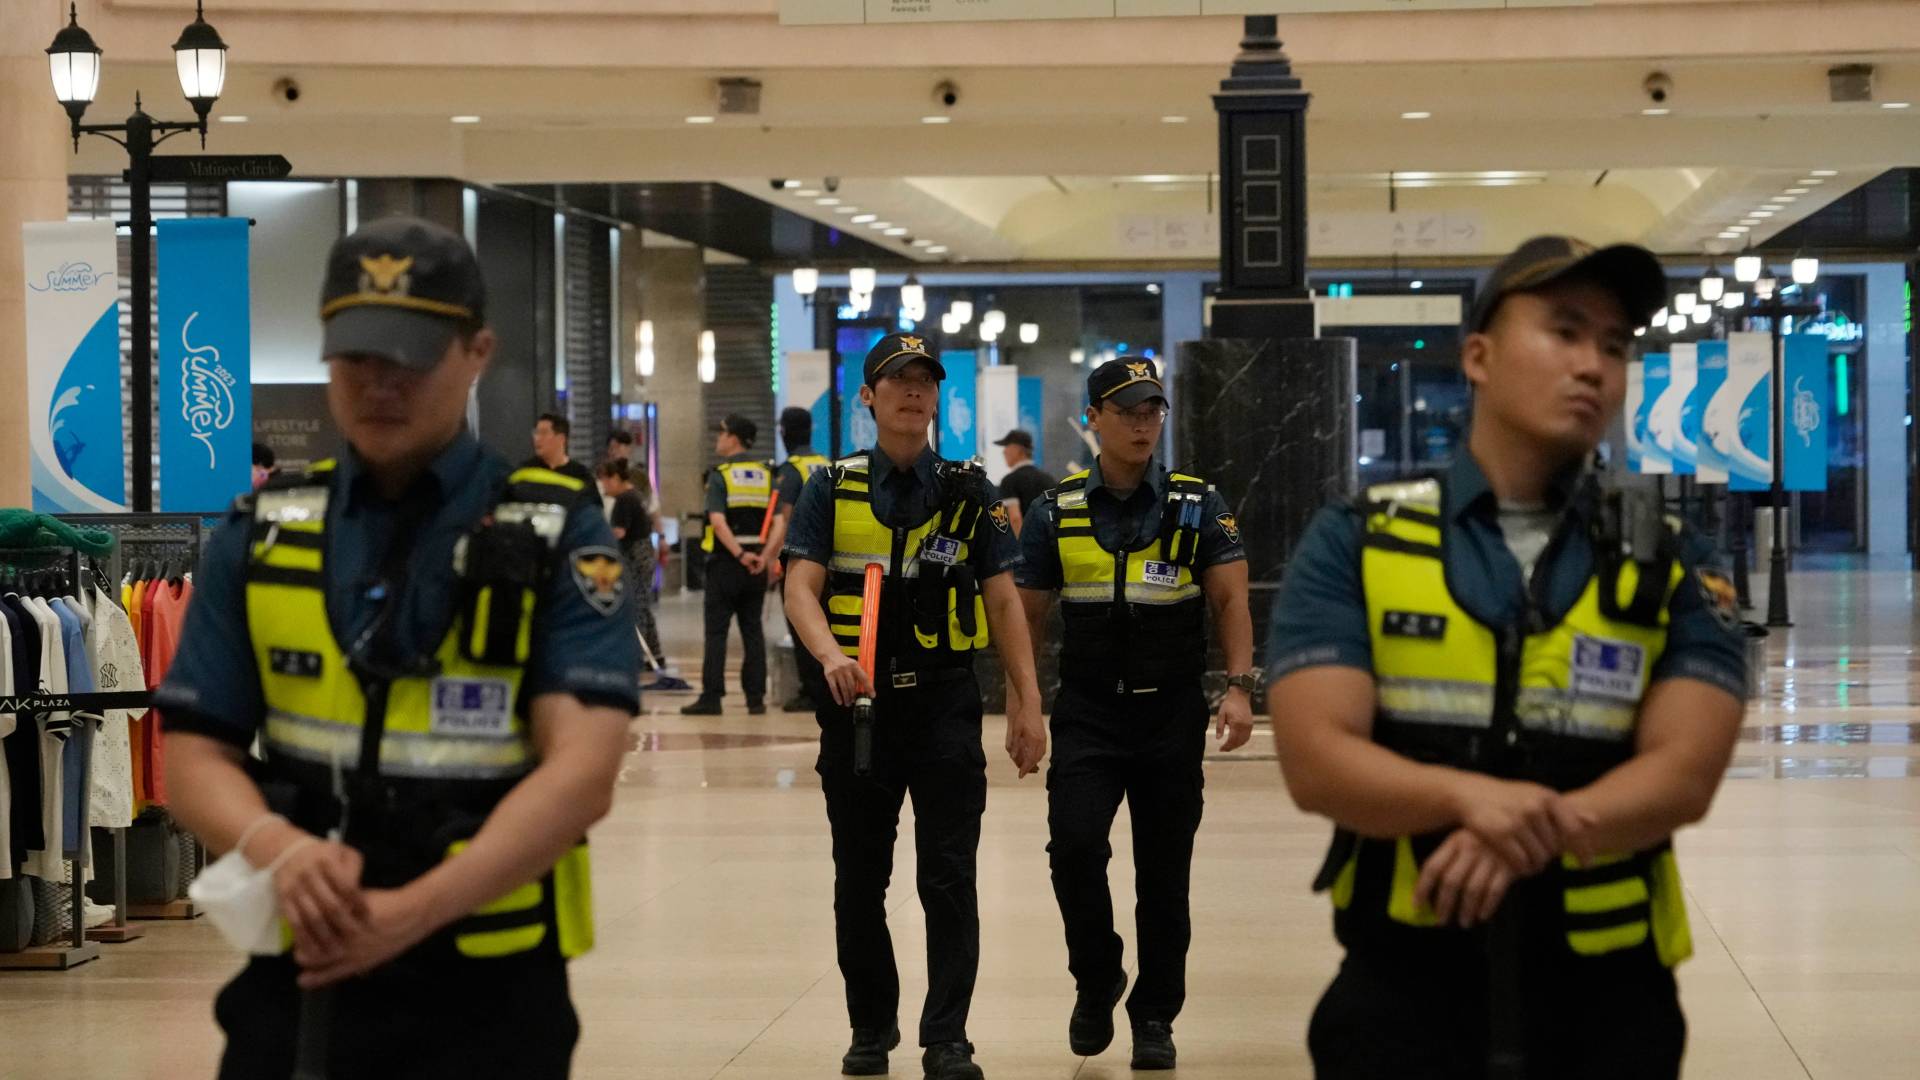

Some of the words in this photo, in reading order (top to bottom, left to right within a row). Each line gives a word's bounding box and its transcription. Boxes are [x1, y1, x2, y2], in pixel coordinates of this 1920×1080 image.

[190, 160, 240, 177] Matinee
[242, 160, 280, 177] Circle
[214, 364, 237, 387] 2023
[266, 433, 307, 447] STORE
[1146, 574, 1175, 585] POLICE
[33, 699, 71, 707] PLAZA
